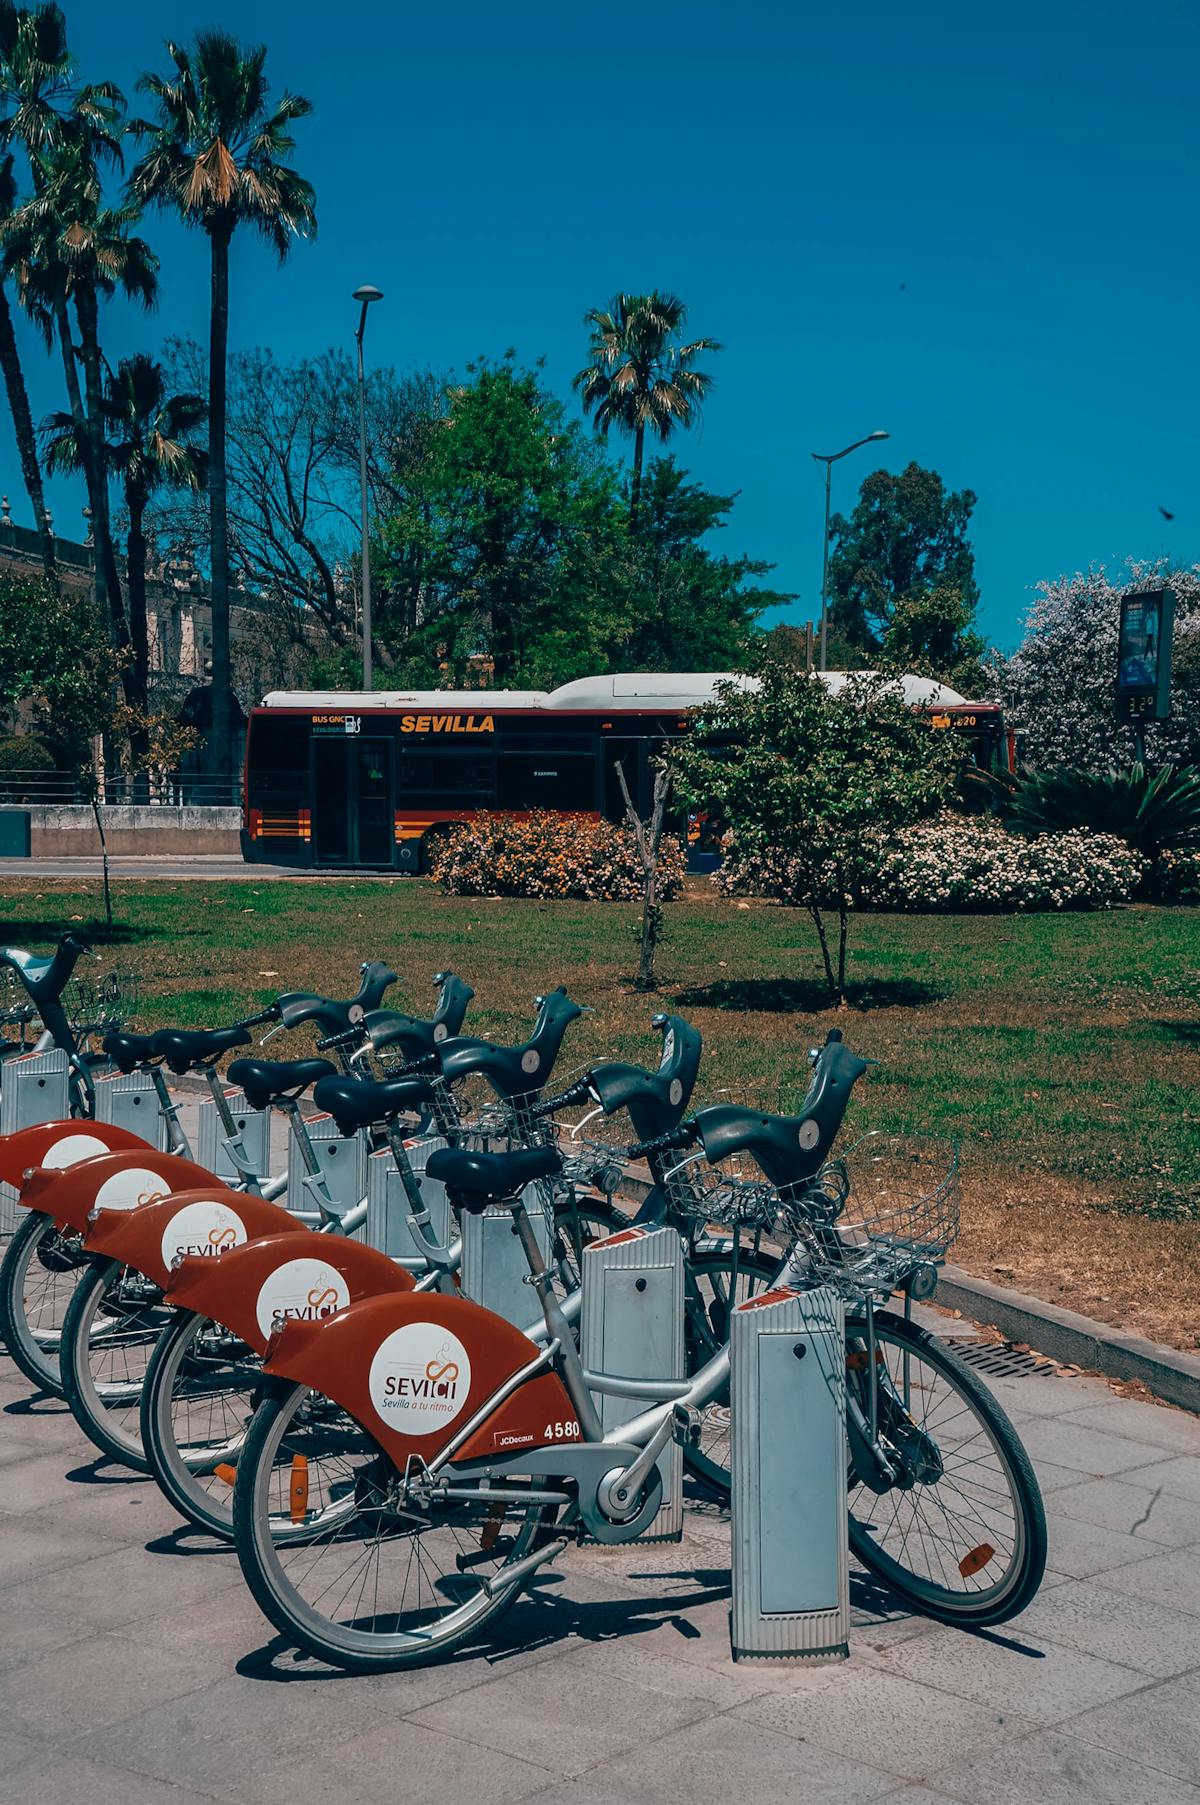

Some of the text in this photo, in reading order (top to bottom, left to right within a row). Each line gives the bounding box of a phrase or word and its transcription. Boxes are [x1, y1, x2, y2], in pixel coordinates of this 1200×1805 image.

[312, 715, 345, 723] BUS GNC
[400, 715, 495, 733] SEVILLA
[382, 1398, 455, 1413] Sevilla a tu ritmo.
[544, 1421, 580, 1440] 4580
[499, 1434, 534, 1446] JCDecaux
